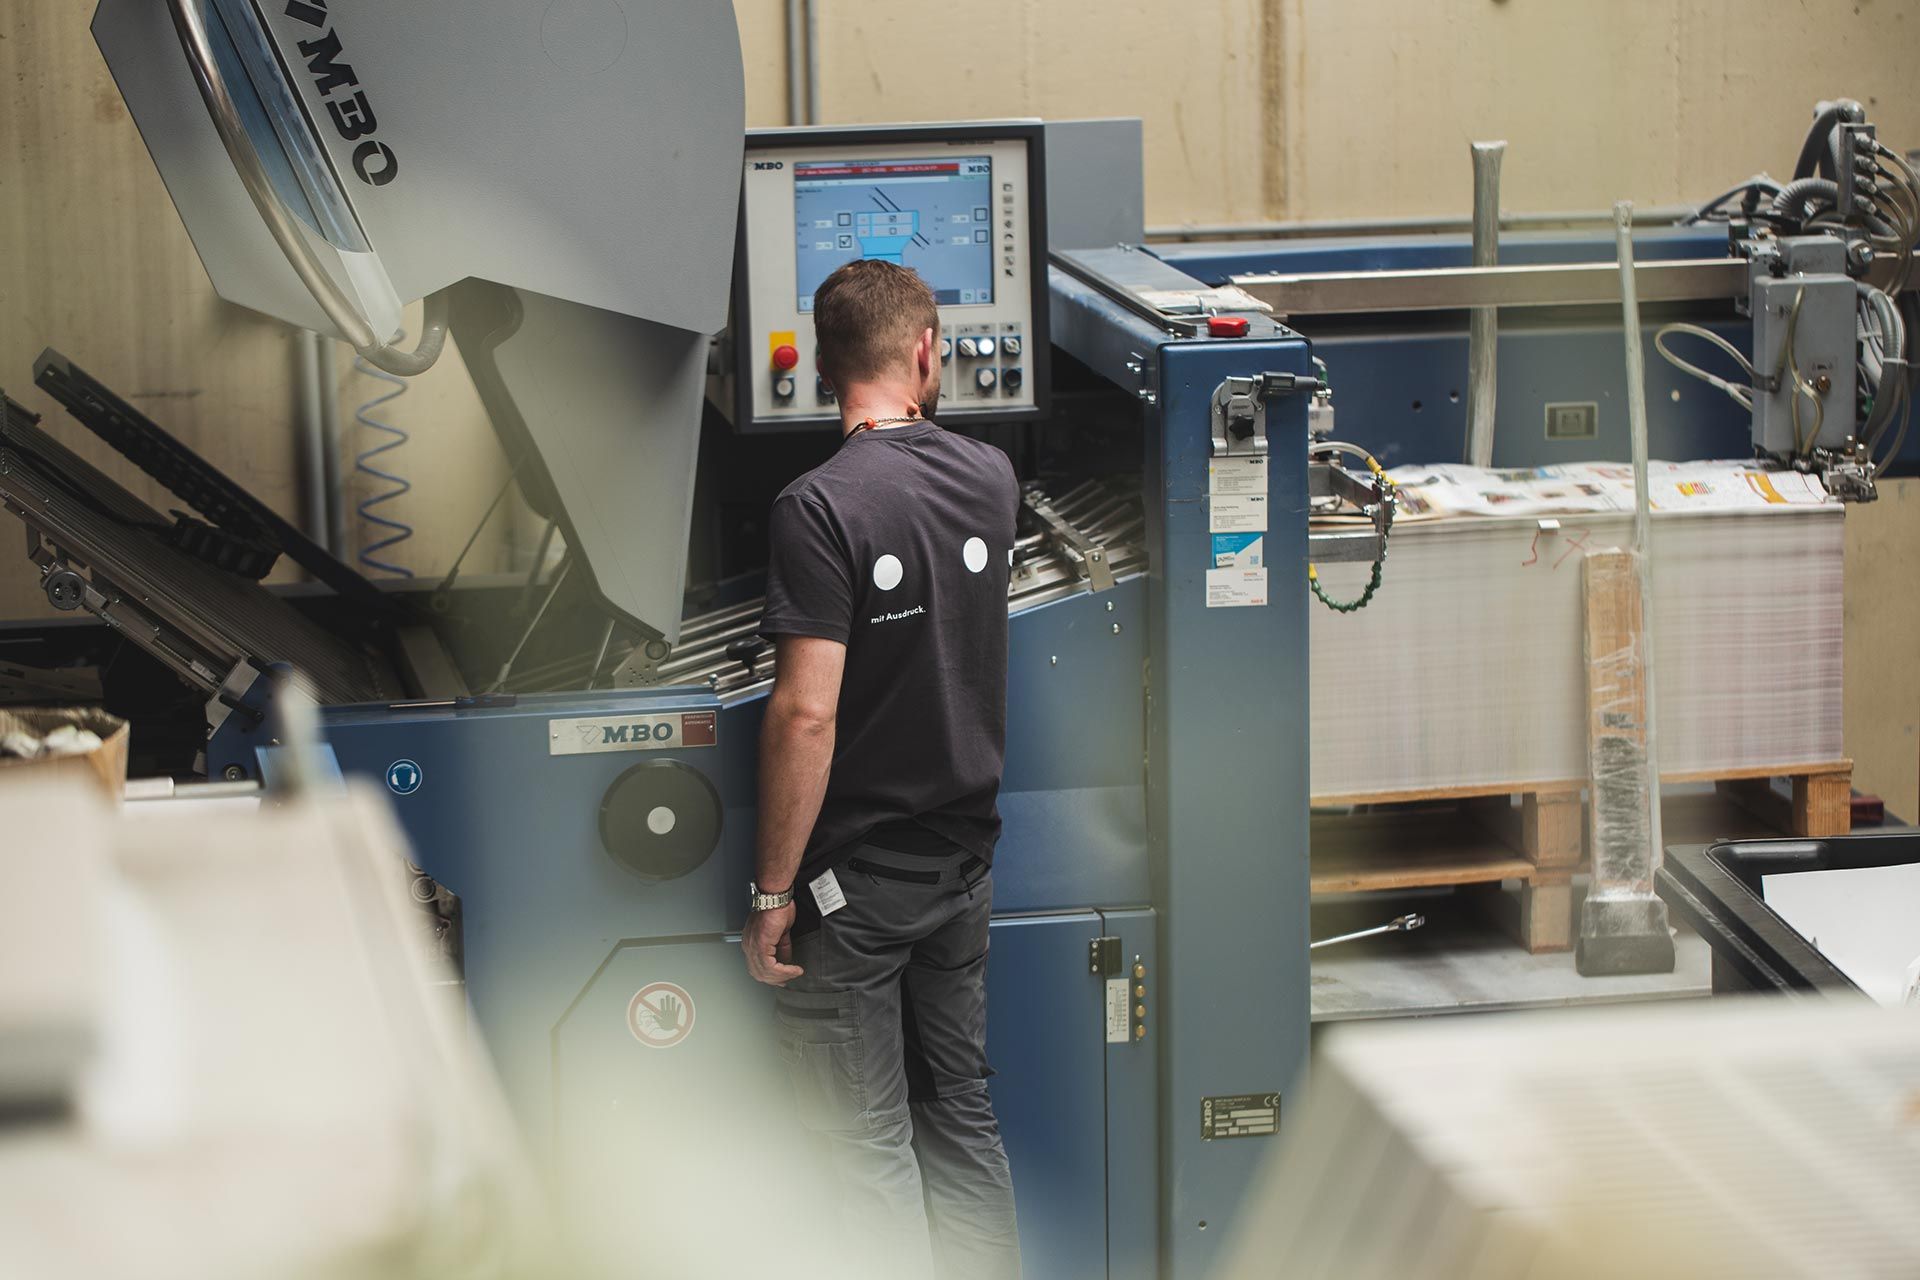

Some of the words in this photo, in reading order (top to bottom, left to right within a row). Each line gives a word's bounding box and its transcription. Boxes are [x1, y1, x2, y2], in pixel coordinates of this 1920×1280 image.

[297, 27, 398, 186] MBO
[754, 162, 783, 171] MBO
[871, 615, 885, 624] mit
[886, 605, 926, 620] Ausdruck.
[602, 723, 673, 744] MBO
